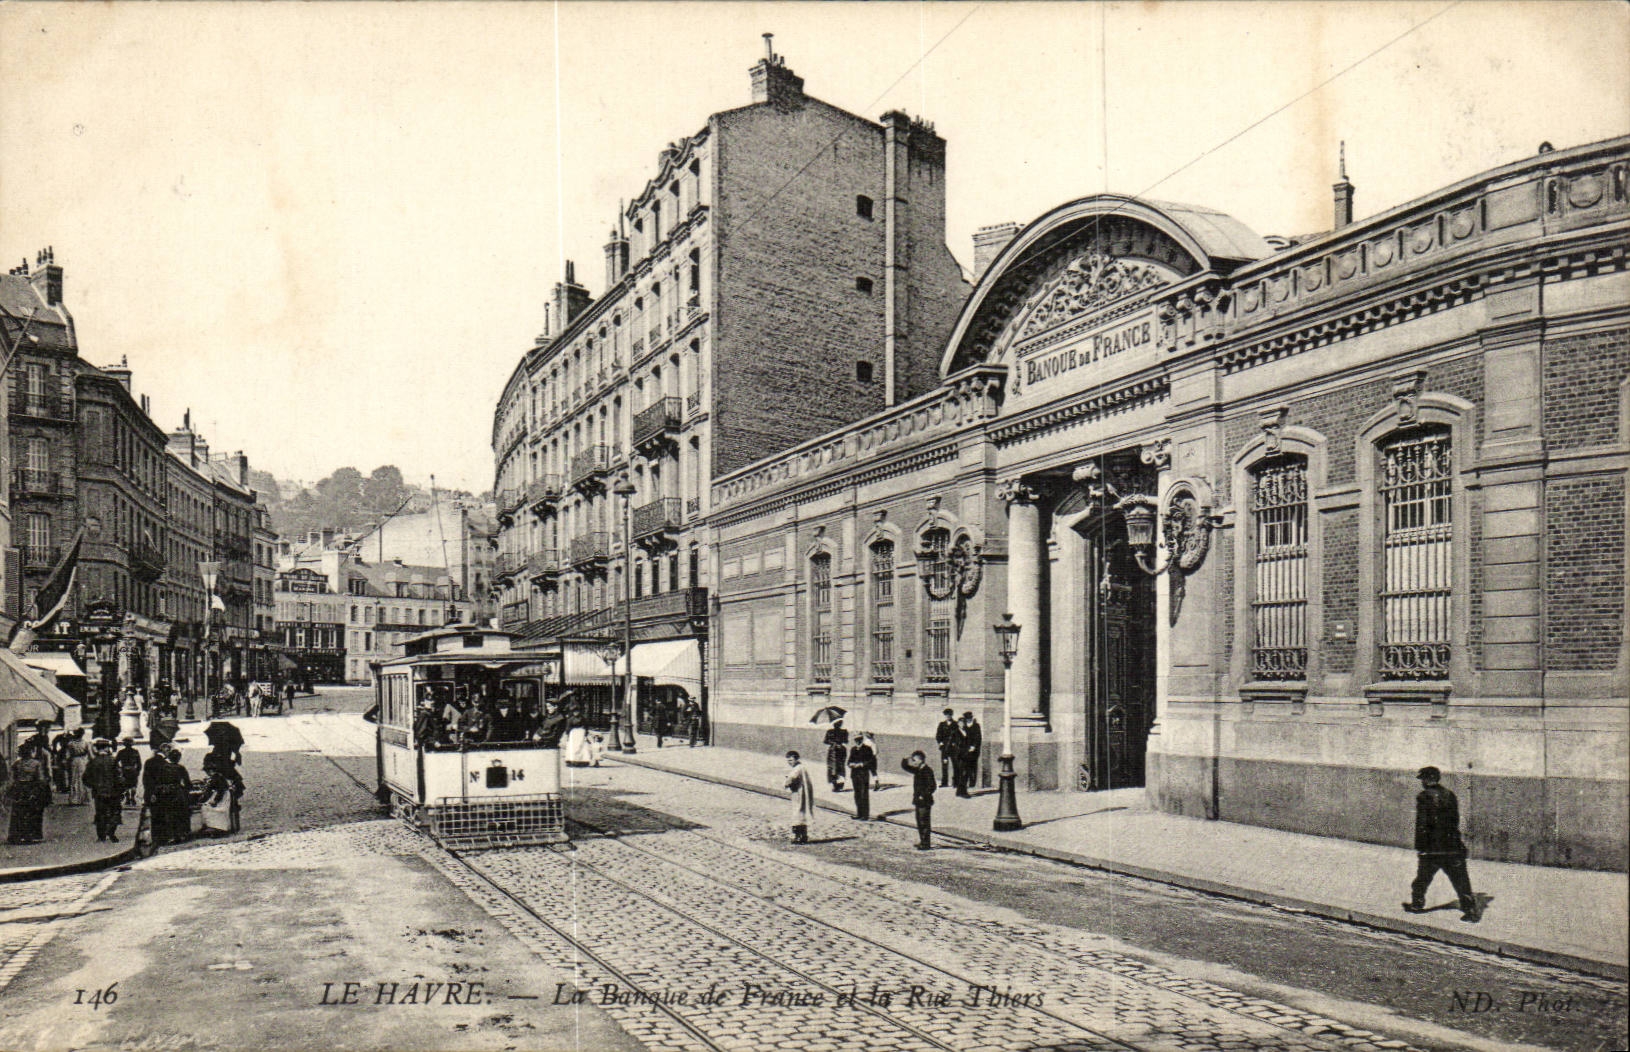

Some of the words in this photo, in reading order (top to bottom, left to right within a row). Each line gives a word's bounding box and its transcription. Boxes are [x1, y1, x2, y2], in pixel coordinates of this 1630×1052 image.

[1026, 350, 1077, 386] BANQUE
[1079, 352, 1091, 367] DE
[1092, 321, 1151, 362] FRANCE
